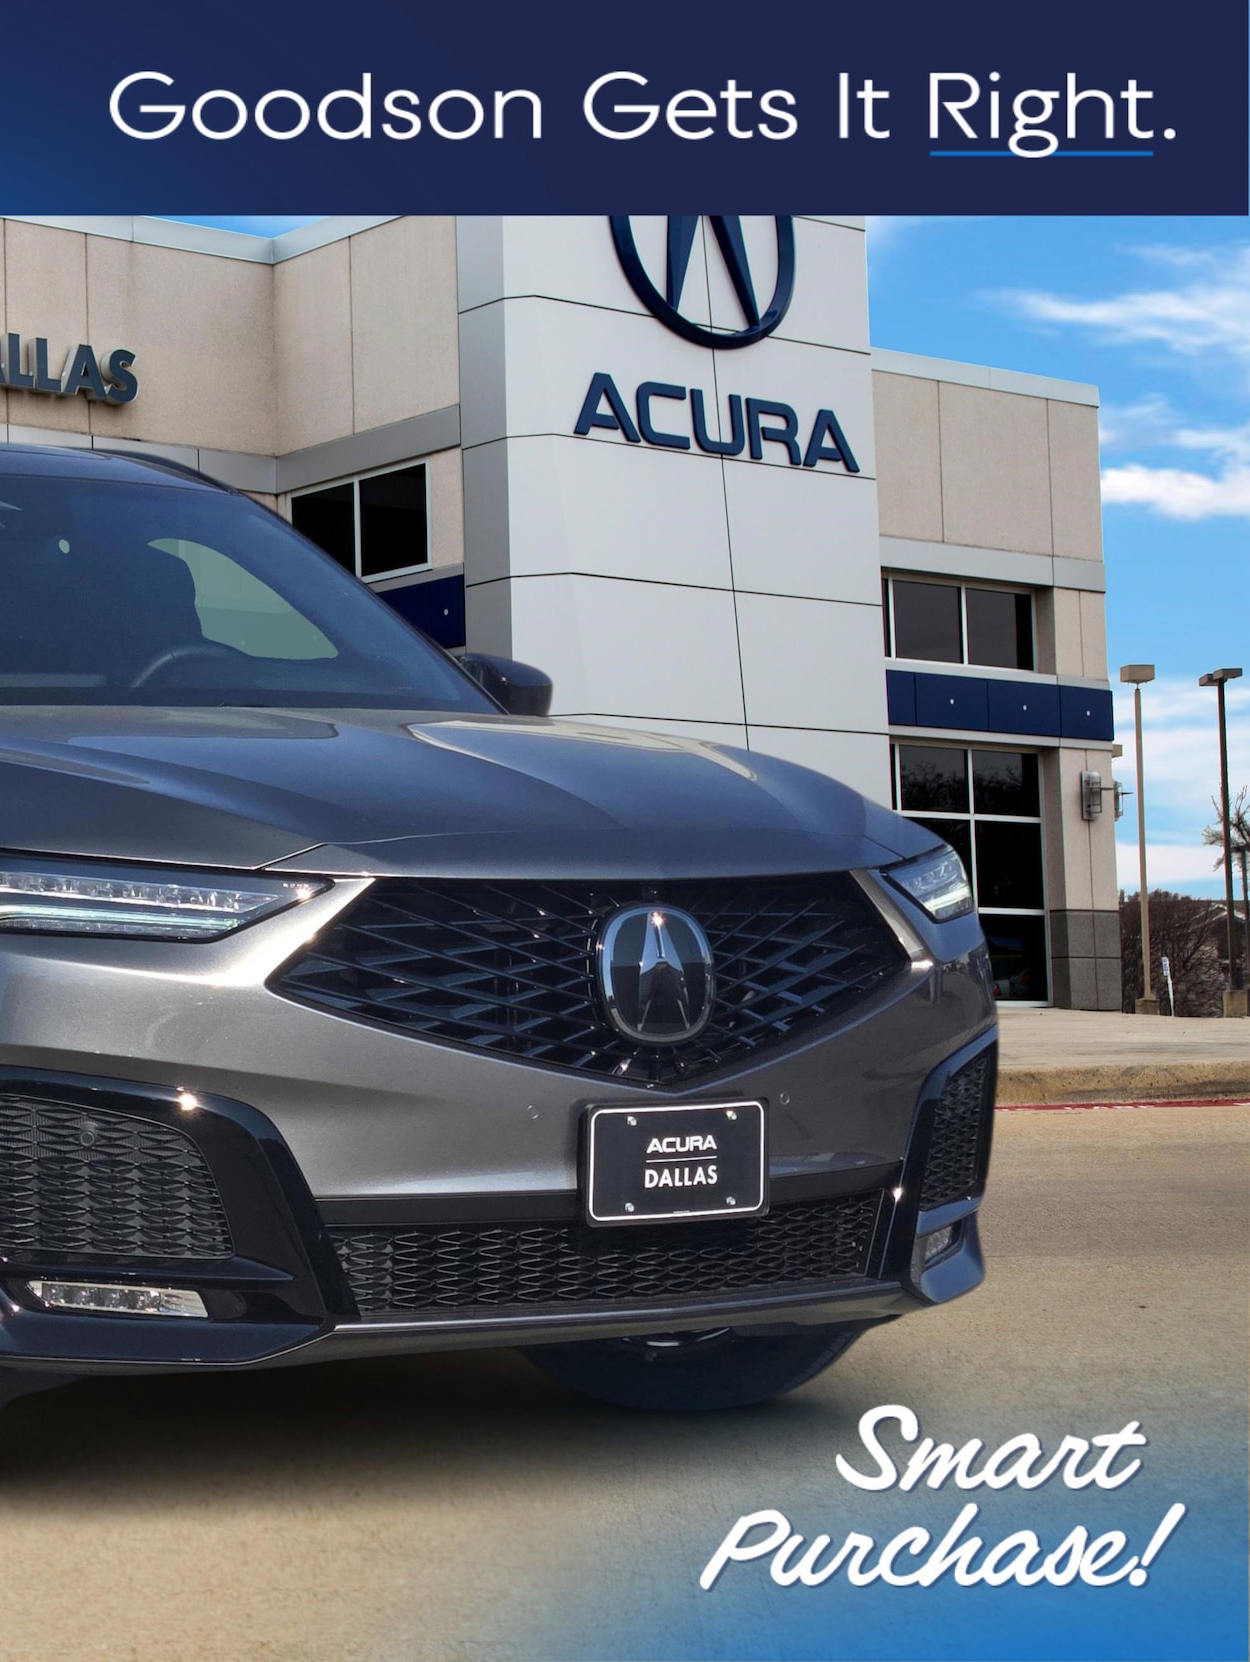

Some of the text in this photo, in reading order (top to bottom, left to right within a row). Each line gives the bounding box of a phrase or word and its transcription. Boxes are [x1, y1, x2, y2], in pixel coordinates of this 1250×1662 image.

[574, 372, 861, 473] ACURA
[646, 1134, 718, 1154] ACURA
[644, 1164, 718, 1189] DALLAS
